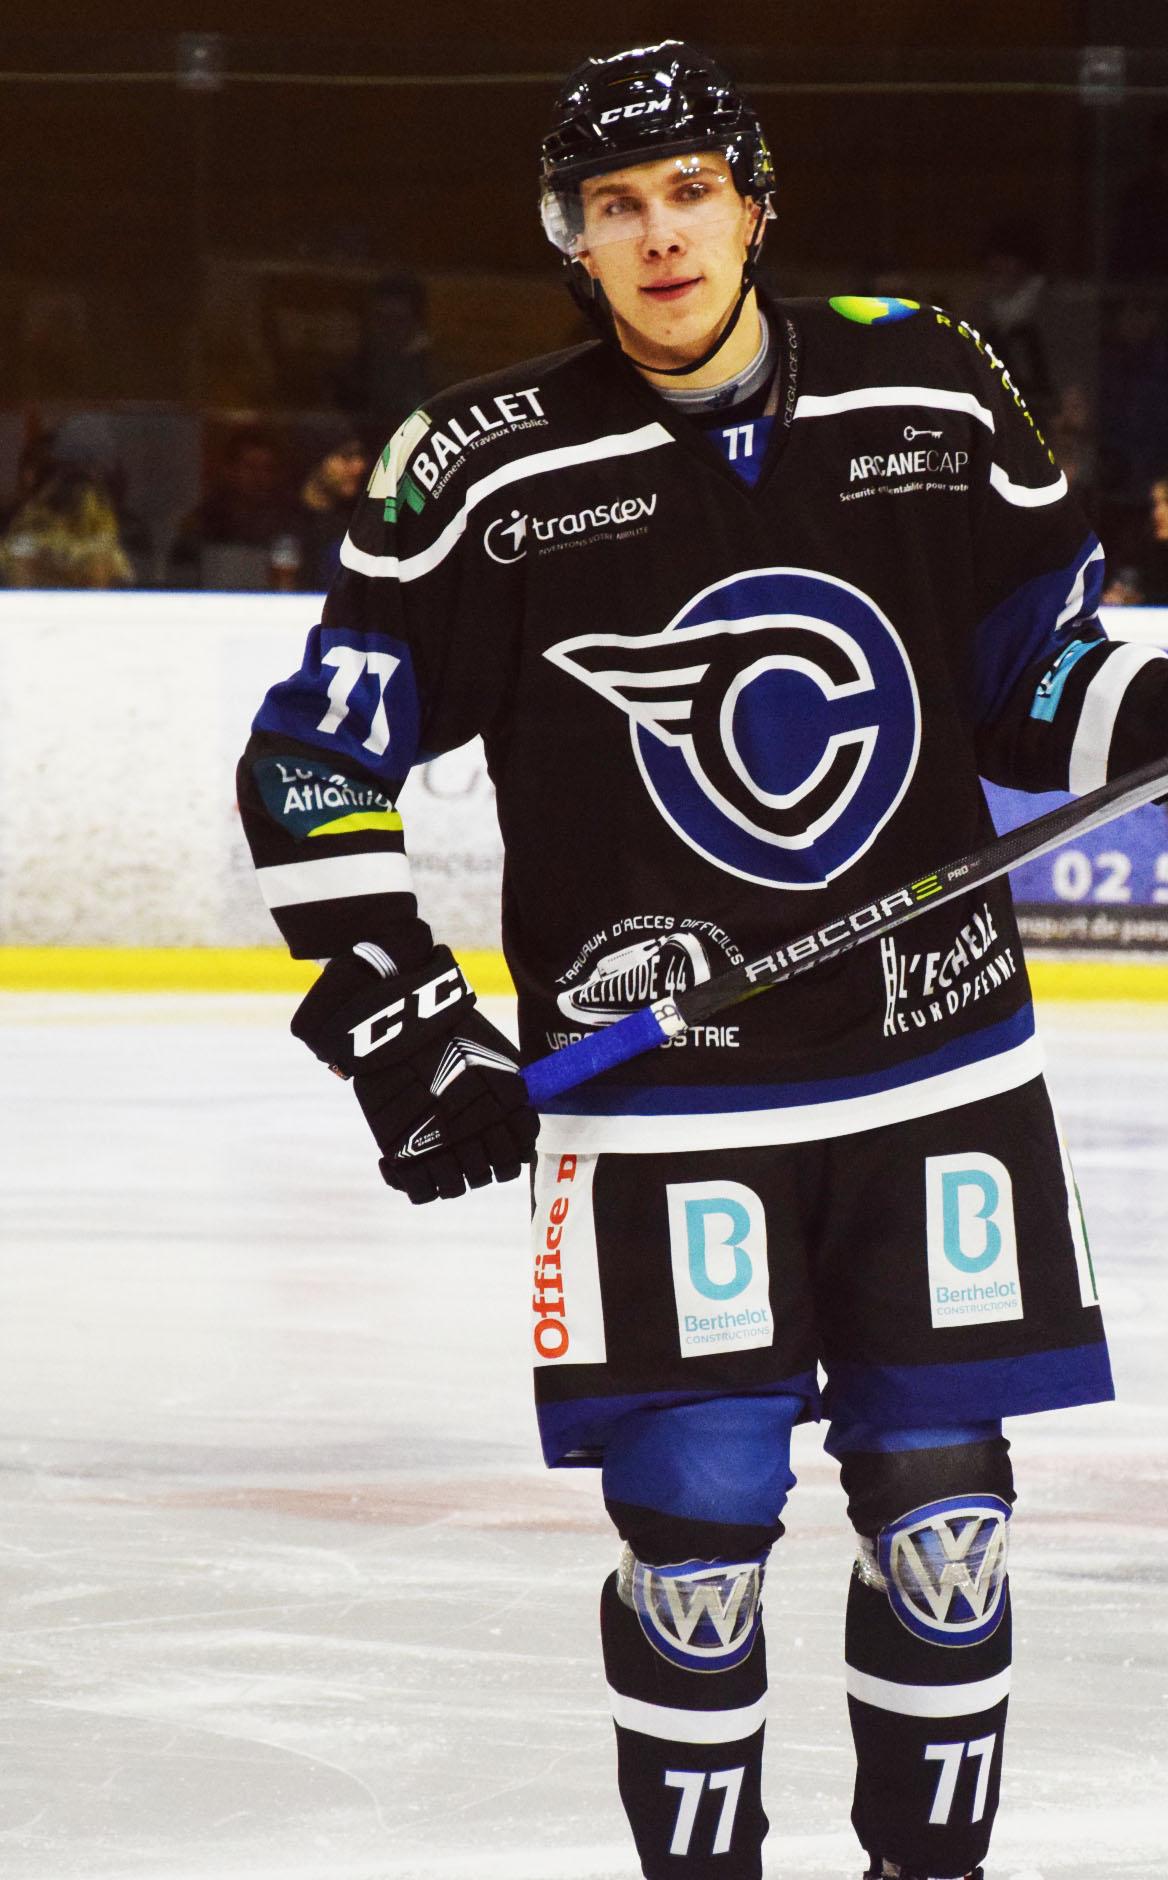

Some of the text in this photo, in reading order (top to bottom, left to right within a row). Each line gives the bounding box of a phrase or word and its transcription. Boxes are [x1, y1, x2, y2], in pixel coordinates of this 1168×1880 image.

[600, 97, 671, 125] CCM
[411, 387, 546, 491] BALLET
[468, 427, 511, 450] Travaux
[511, 417, 549, 432] Publics
[722, 424, 754, 460] 77
[848, 450, 969, 482] ARCANECAP
[926, 481, 947, 491] pour
[316, 645, 401, 756] 77
[947, 864, 969, 881] PRO
[1052, 850, 1131, 902] 02
[555, 930, 608, 985] TRAVAUX
[612, 915, 675, 937] D'ACCES
[680, 918, 745, 966] DIFFICILES
[579, 954, 687, 1004] ALTITUDE 44
[347, 966, 474, 1058] CC
[532, 1197, 570, 1359] Office
[936, 1281, 1017, 1303] Berthelot
[684, 1308, 769, 1332] Berthelot
[936, 1299, 1018, 1316] CONSTRUCTIONS
[685, 1327, 770, 1345] CONSTRUCTIONS
[924, 1731, 998, 1825] 77
[664, 1765, 746, 1857] 77
